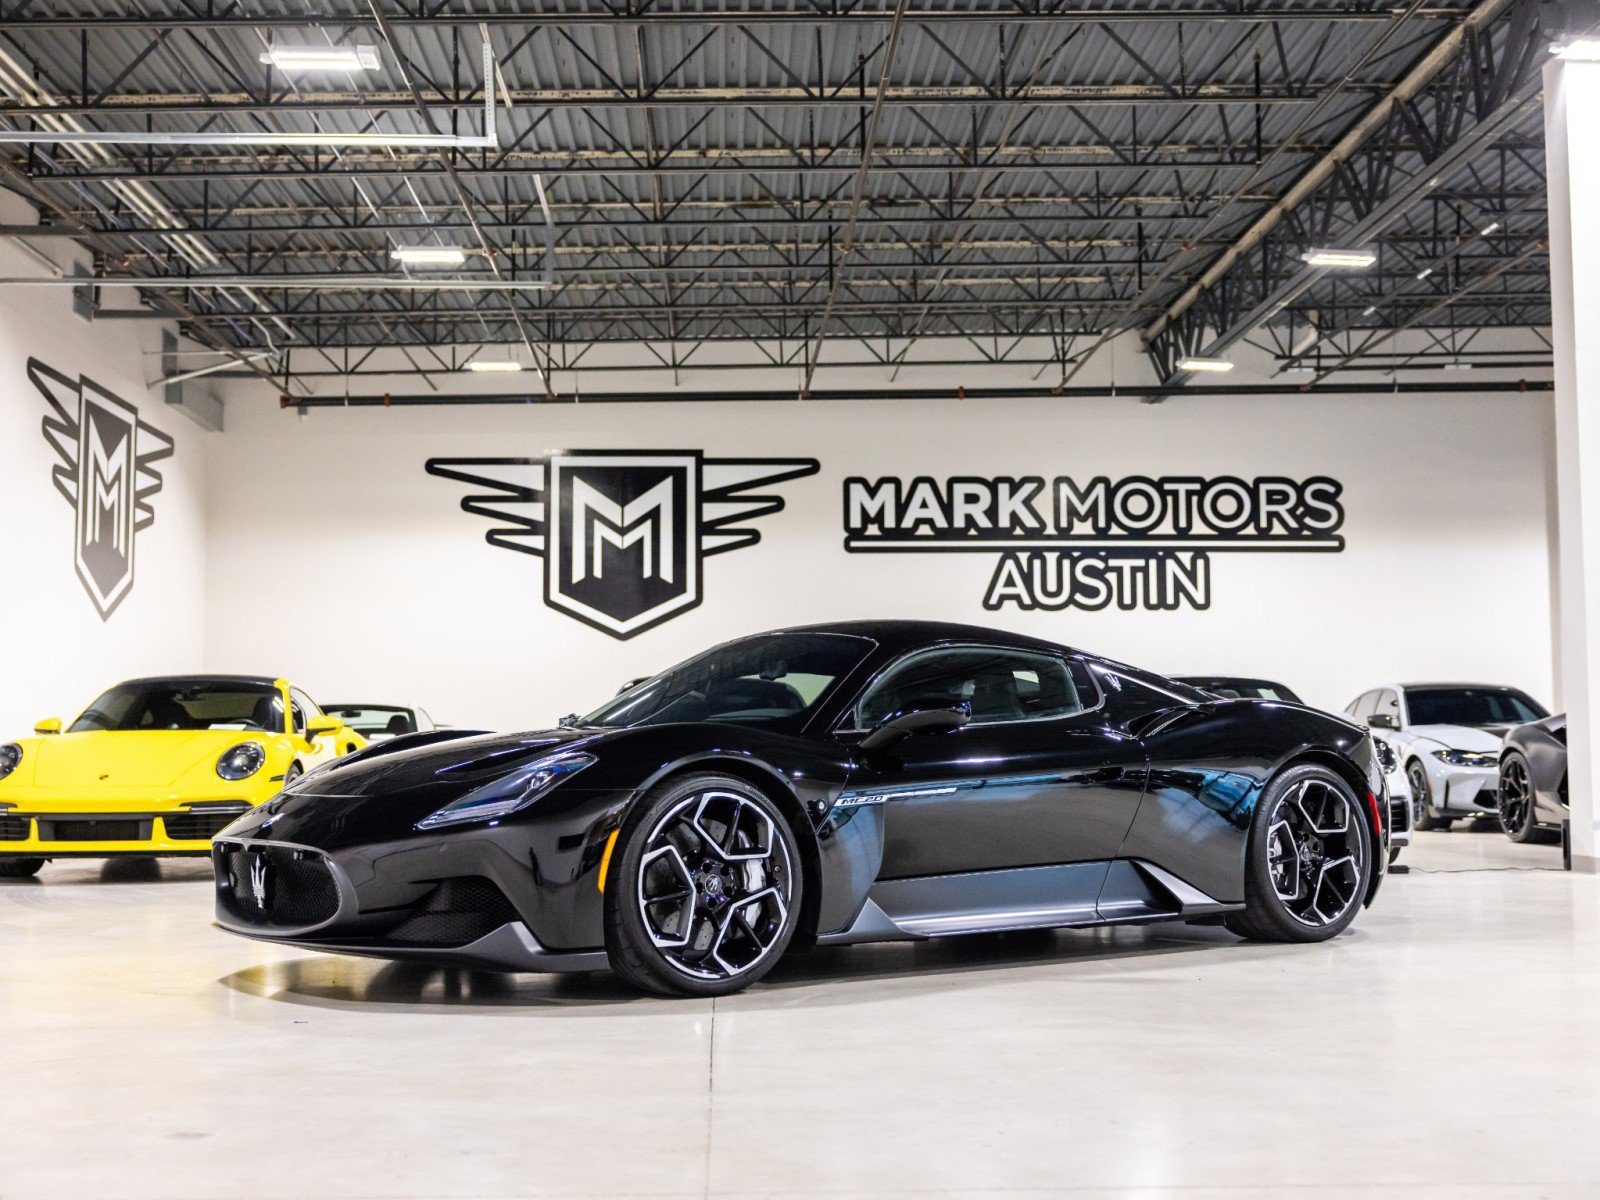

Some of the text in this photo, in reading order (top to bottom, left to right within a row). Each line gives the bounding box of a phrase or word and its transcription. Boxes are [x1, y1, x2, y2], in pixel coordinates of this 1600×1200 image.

[847, 480, 1341, 530] MARK MOTORS
[987, 556, 1206, 607] AUSTIN
